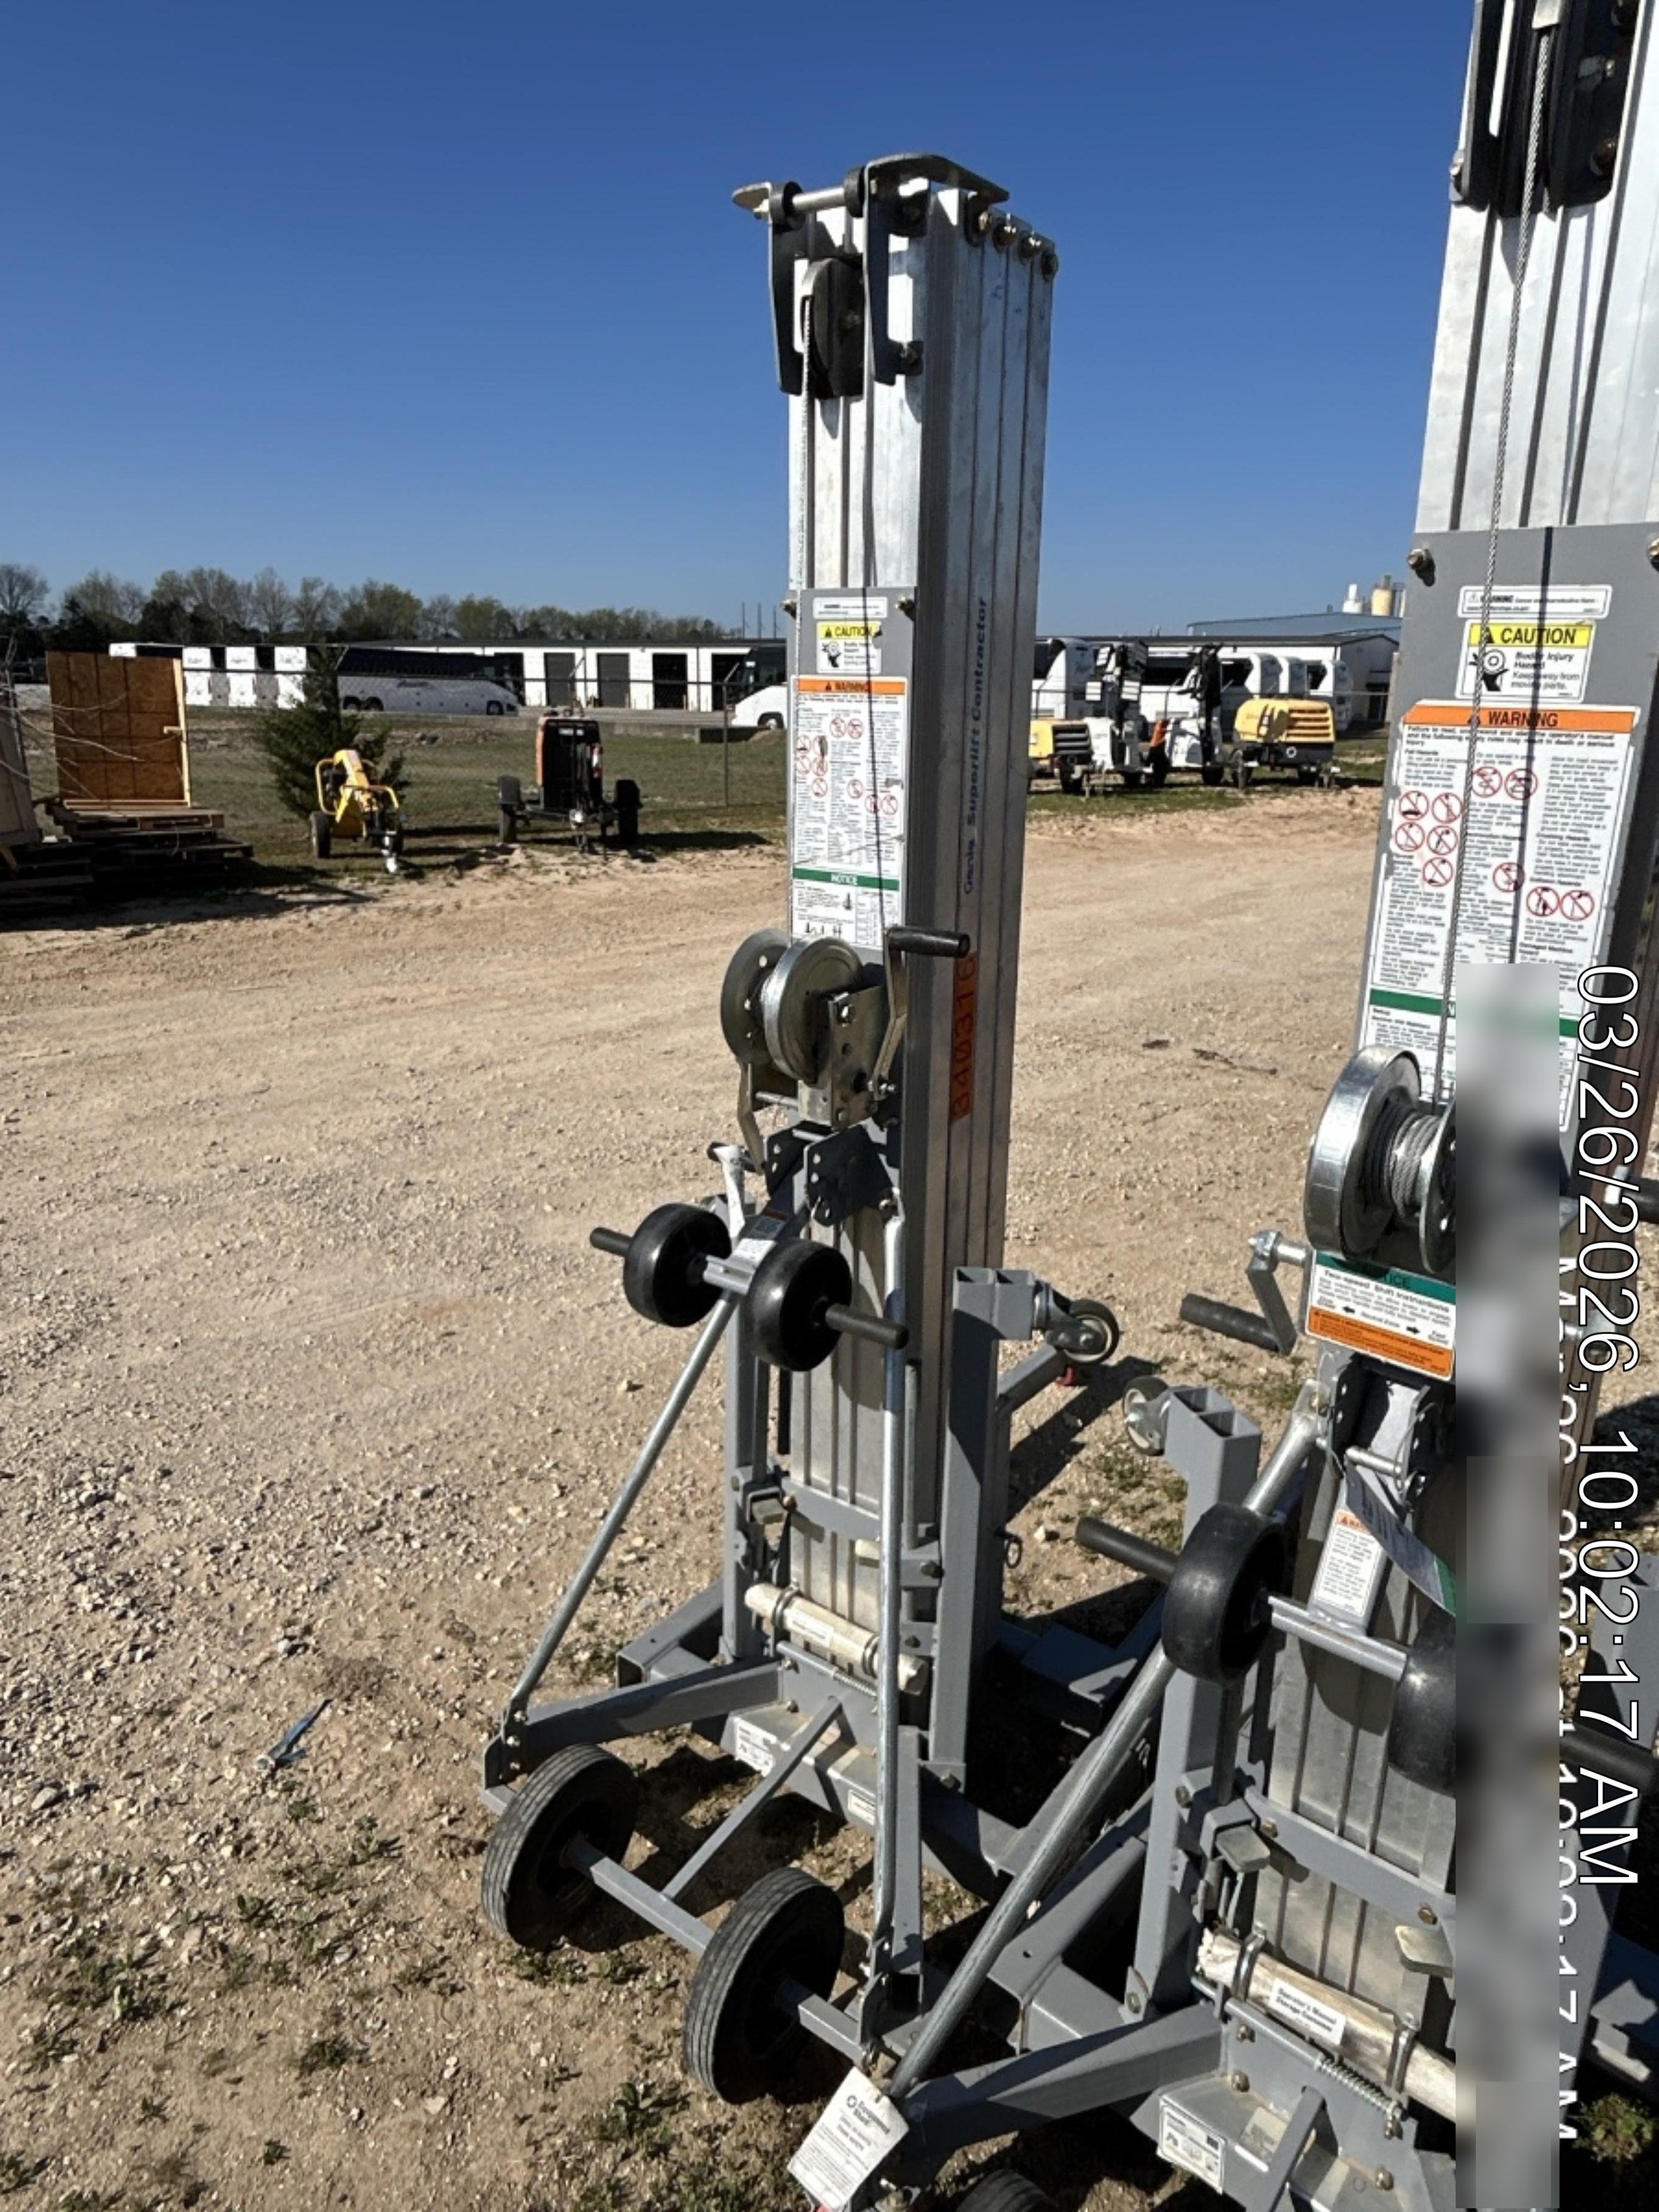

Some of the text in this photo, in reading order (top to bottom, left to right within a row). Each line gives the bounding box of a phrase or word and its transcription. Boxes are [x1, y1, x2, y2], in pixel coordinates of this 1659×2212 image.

[1500, 627, 1577, 645] CAUTION
[971, 597, 987, 721] Contractor
[1547, 652, 1574, 662] Injury
[1488, 711, 1558, 727] WARNING
[967, 728, 980, 826] Superlift
